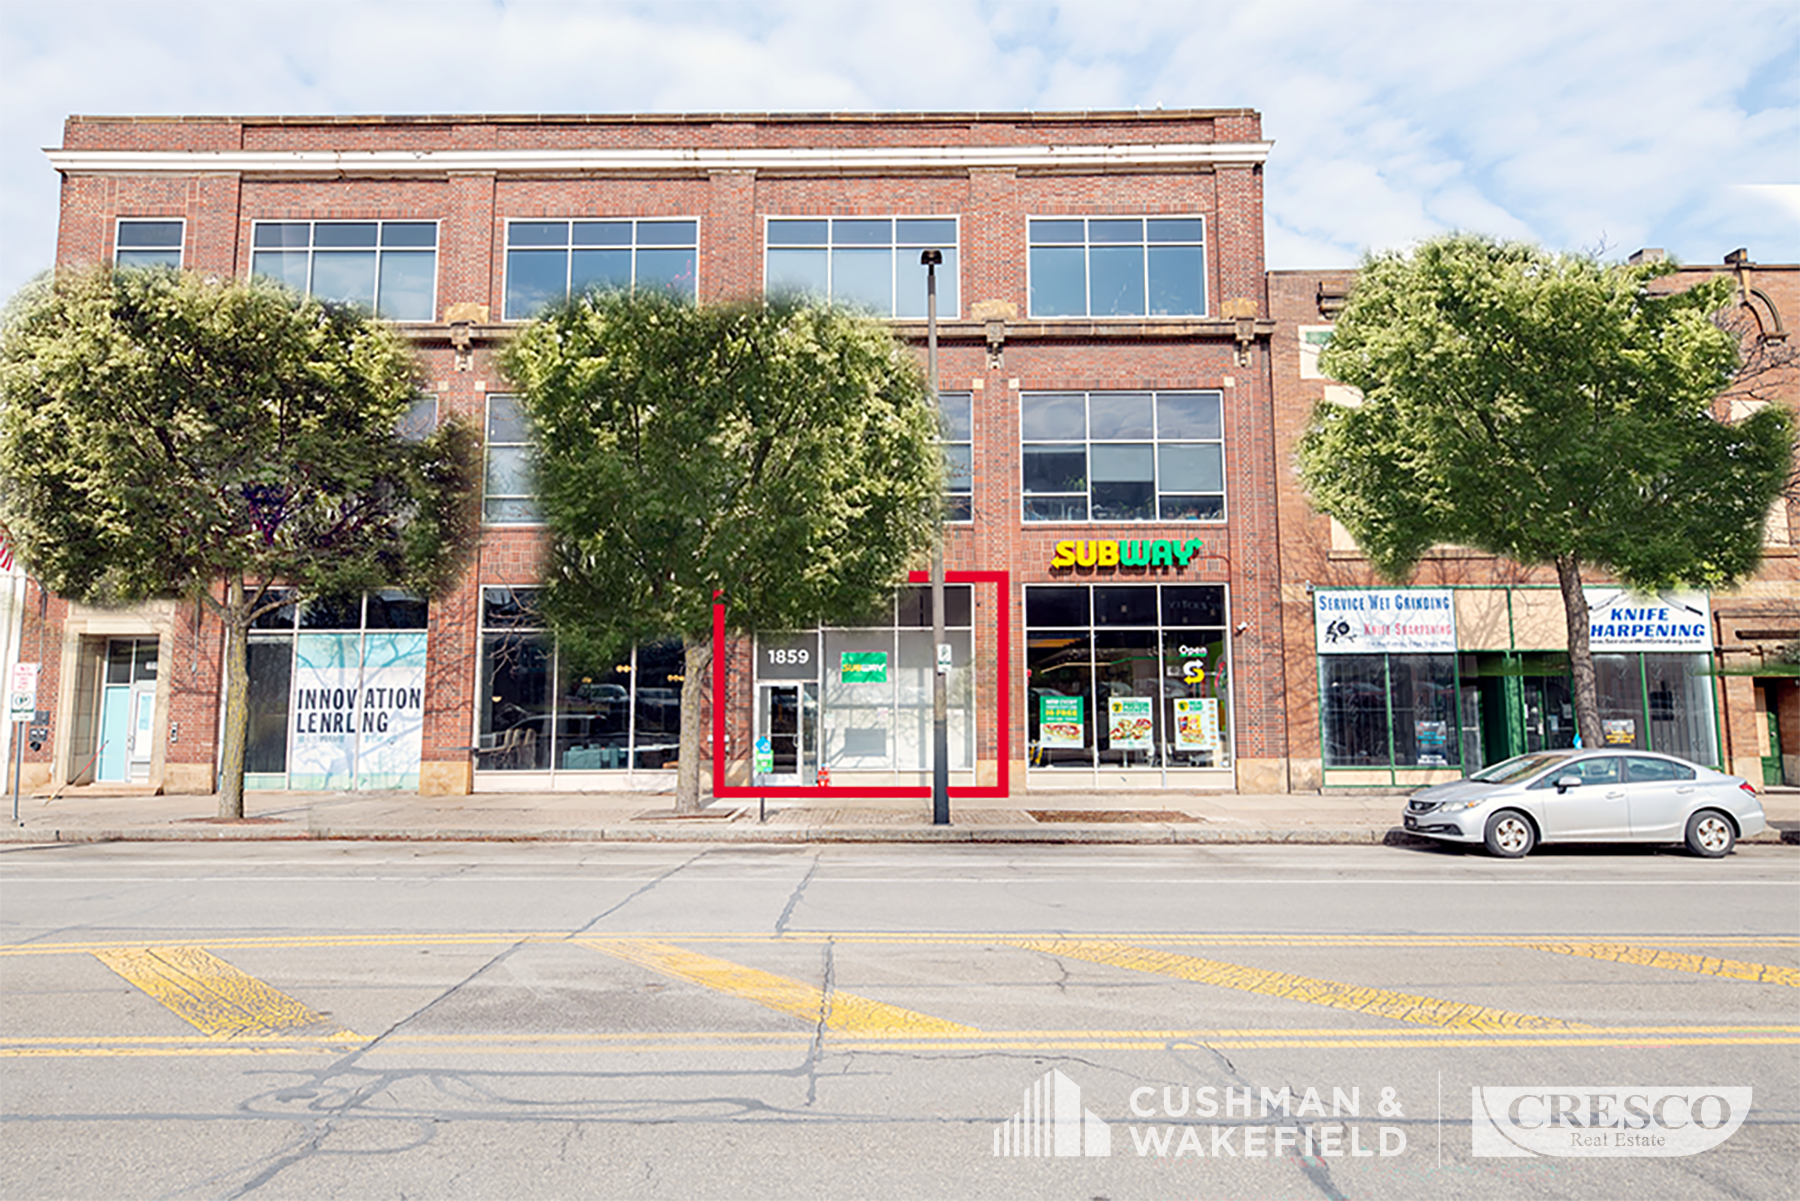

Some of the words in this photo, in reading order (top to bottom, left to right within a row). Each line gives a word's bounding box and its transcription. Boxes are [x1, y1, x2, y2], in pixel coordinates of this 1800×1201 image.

[1050, 537, 1203, 569] SUBWAY
[1319, 595, 1364, 611] SERVICE
[1368, 594, 1390, 610] WET
[1395, 594, 1450, 611] GRINDING
[1611, 608, 1669, 621] KNIFE
[1590, 624, 1705, 637] HARPENING
[768, 649, 810, 665] 1859
[1179, 645, 1207, 655] Open
[298, 688, 421, 710] INNOVATION
